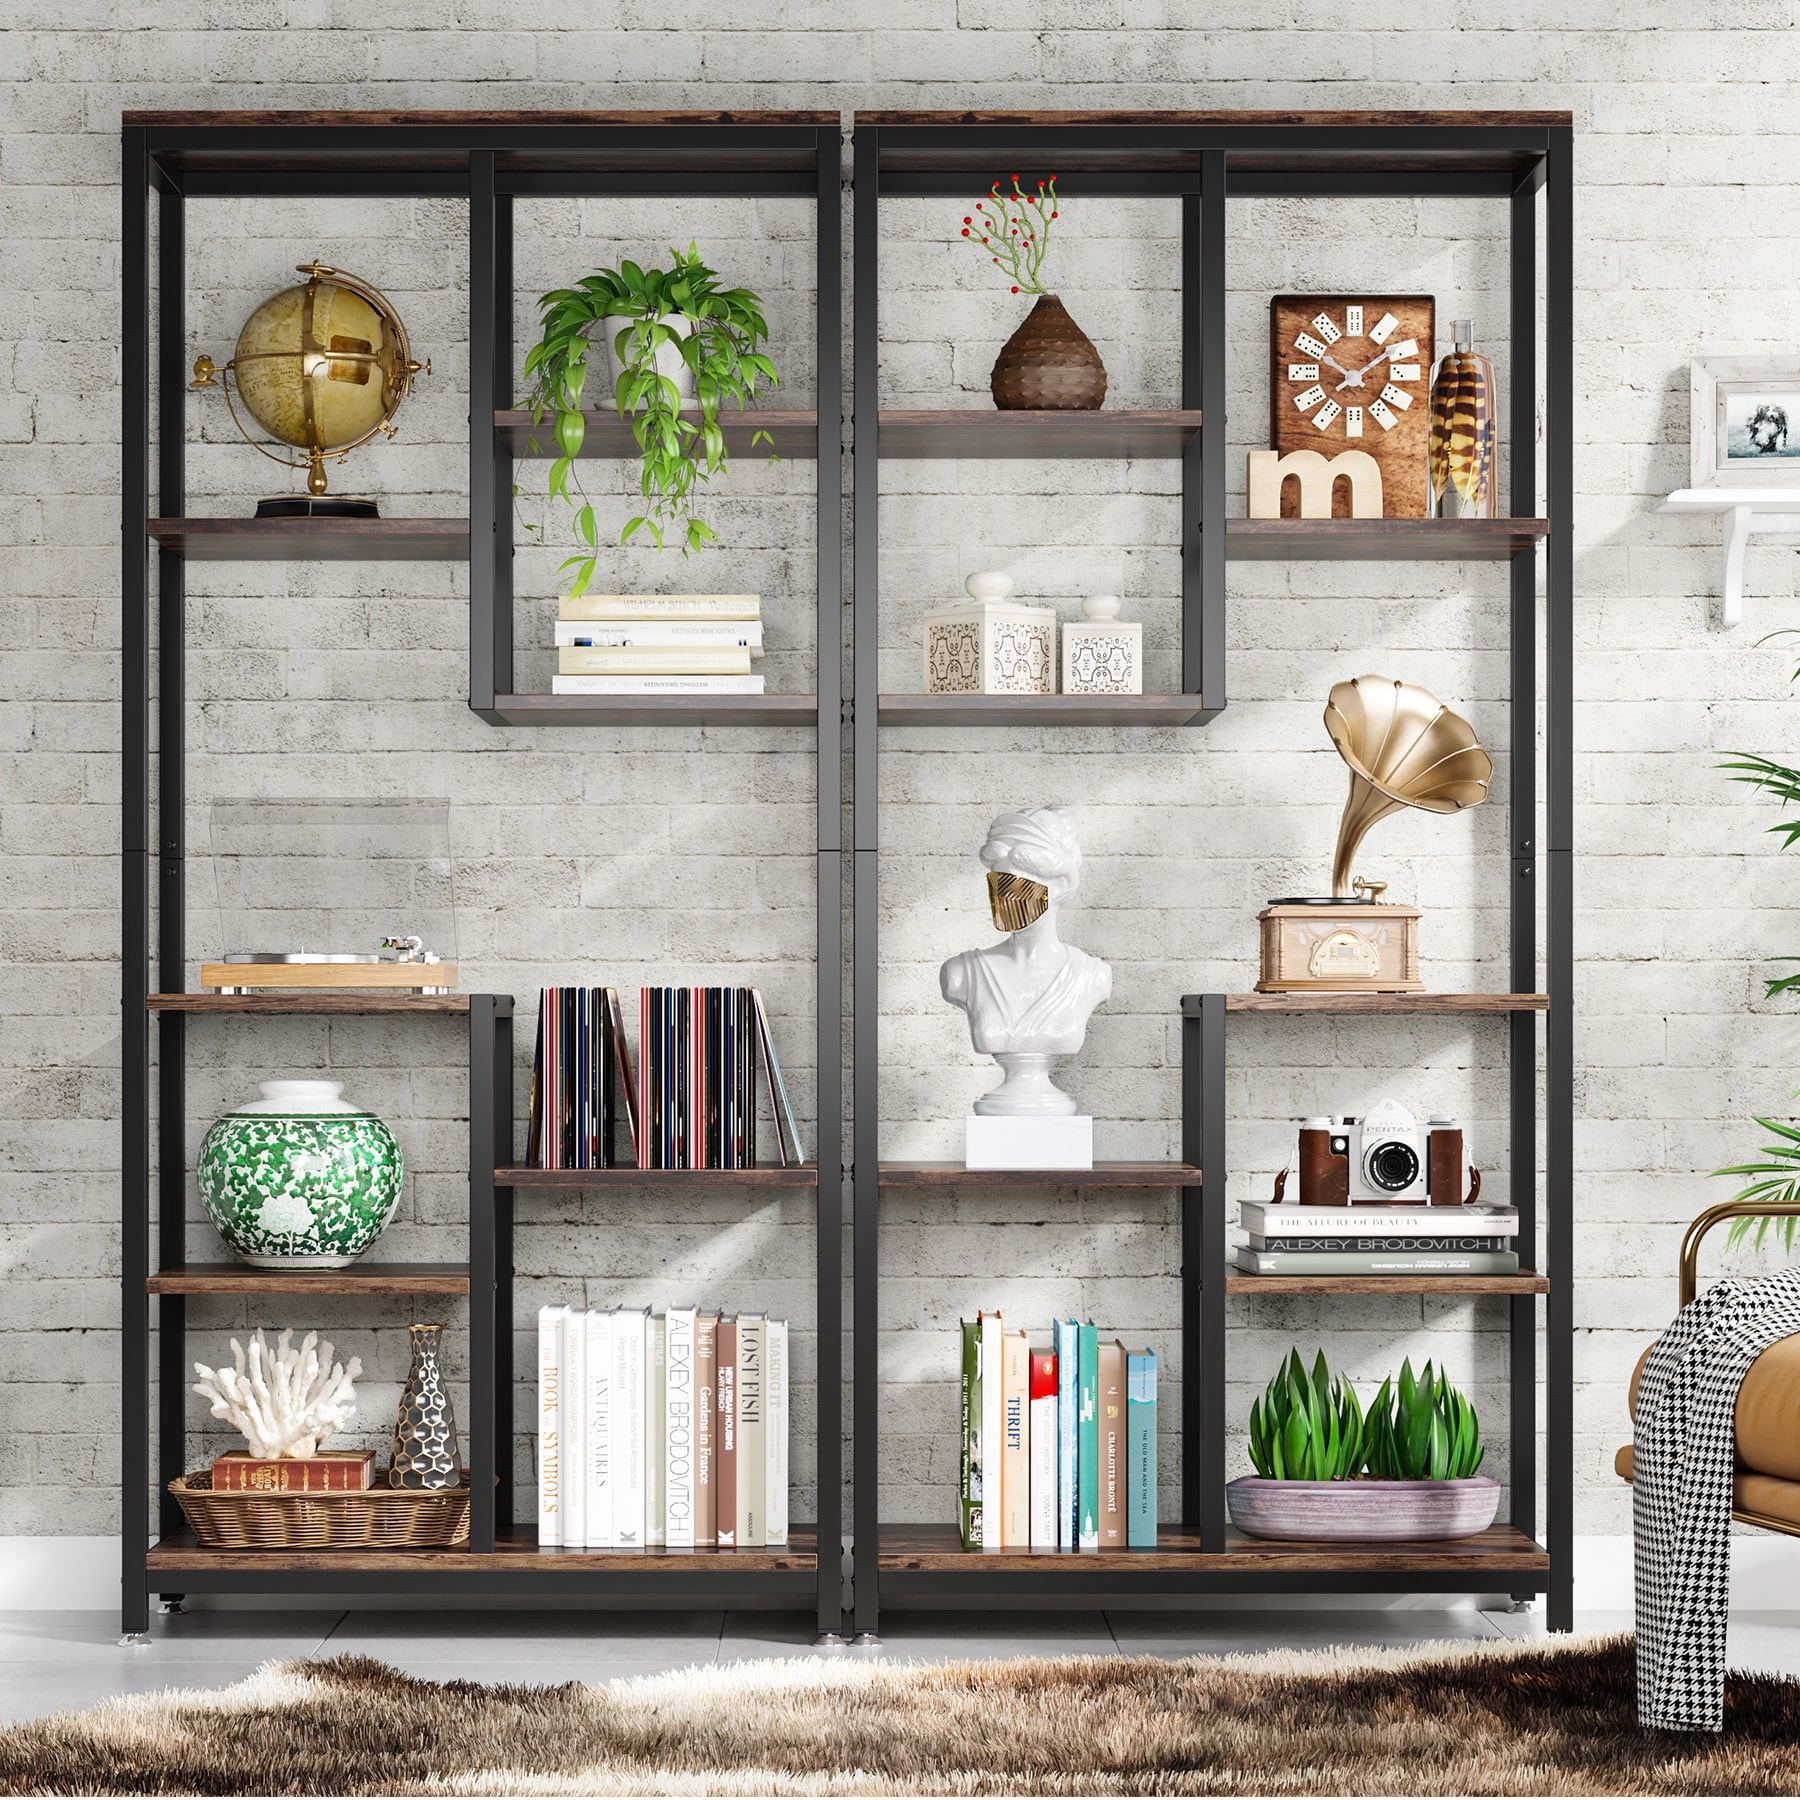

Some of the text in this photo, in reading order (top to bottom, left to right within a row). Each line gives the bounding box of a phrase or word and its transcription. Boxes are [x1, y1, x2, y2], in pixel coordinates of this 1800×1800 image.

[1247, 450, 1383, 519] m
[1271, 1238, 1490, 1250] ALEXEY BRODOVITCH
[569, 1329, 577, 1364] FORMULA
[669, 1318, 689, 1395] ALEXEY
[770, 1337, 781, 1391] MAKING
[543, 1367, 559, 1413] BOOK
[569, 1371, 577, 1398] WORLD
[741, 1327, 759, 1423] LOST FISH
[770, 1394, 780, 1408] IT
[569, 1400, 577, 1444] CHAMPIONS
[593, 1375, 609, 1488] ANTIQUAIRES
[699, 1386, 711, 1484] Gardens in France
[1008, 1397, 1021, 1450] THRIFT
[543, 1431, 559, 1513] SYMBOLS
[630, 1450, 638, 1489] Architecture
[669, 1402, 689, 1531] BRODOVITCH
